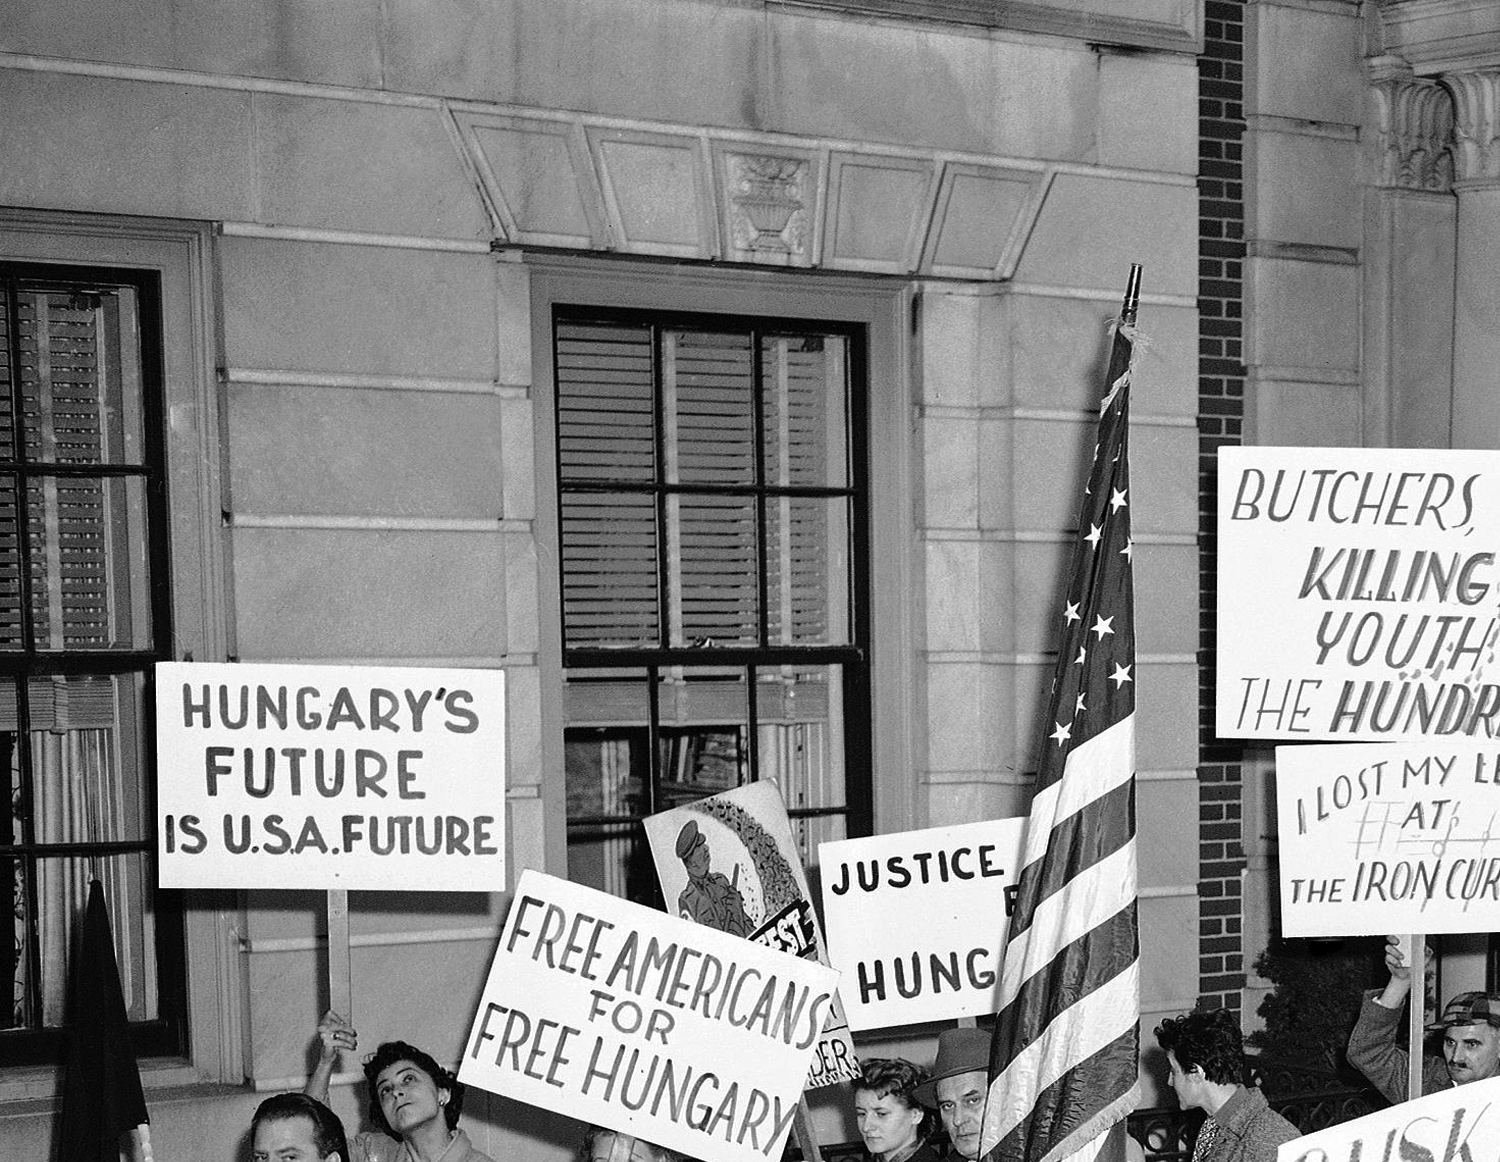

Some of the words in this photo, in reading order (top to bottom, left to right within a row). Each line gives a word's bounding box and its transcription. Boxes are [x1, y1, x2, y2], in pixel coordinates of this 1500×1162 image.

[1299, 546, 1496, 607] KILLING
[1315, 611, 1496, 670] YOUTH
[182, 683, 480, 734] HUNGARY'S
[1236, 677, 1322, 732] THE
[205, 746, 427, 800] FUTURE
[1297, 798, 1307, 836] I
[1316, 761, 1388, 822] LOST
[1401, 755, 1457, 791] MY
[165, 814, 208, 854] IS
[341, 815, 499, 856] FUTURE
[1401, 799, 1452, 830] AT
[831, 845, 1005, 896] JUSTICE
[1291, 878, 1346, 904] THE
[1352, 859, 1442, 902] IRON
[507, 895, 615, 981] FREE
[605, 930, 831, 1050] AMERICANS
[588, 989, 676, 1045] FOR
[471, 1002, 581, 1088] FREE
[581, 1036, 798, 1156] HUNGARY
